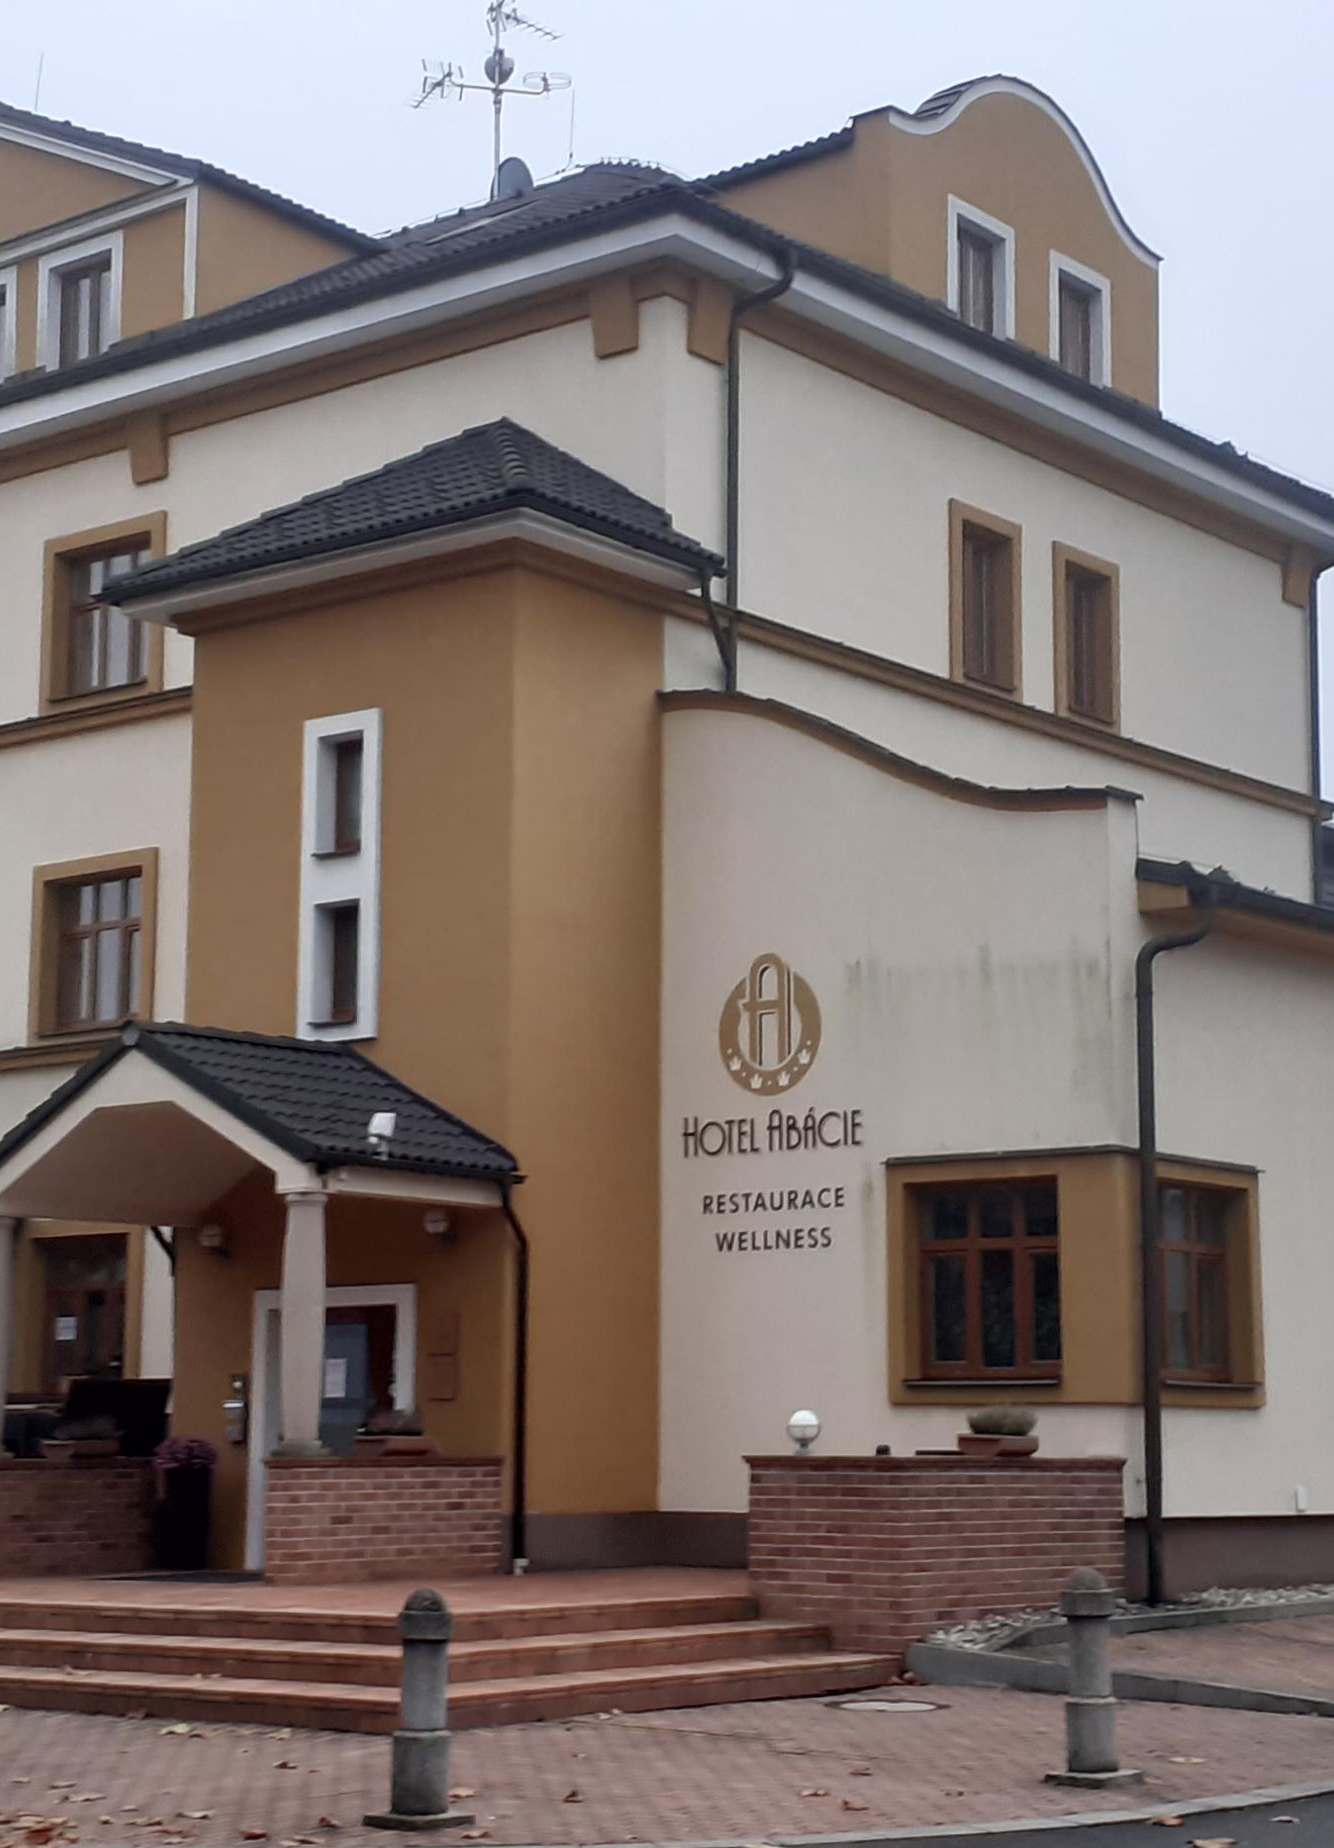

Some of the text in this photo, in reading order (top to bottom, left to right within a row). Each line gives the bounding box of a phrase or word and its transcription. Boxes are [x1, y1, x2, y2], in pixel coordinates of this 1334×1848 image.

[682, 1106, 862, 1159] HOTEL ABÁCIE
[702, 1186, 845, 1215] RESTAURACE
[716, 1227, 832, 1252] WELLNESS
